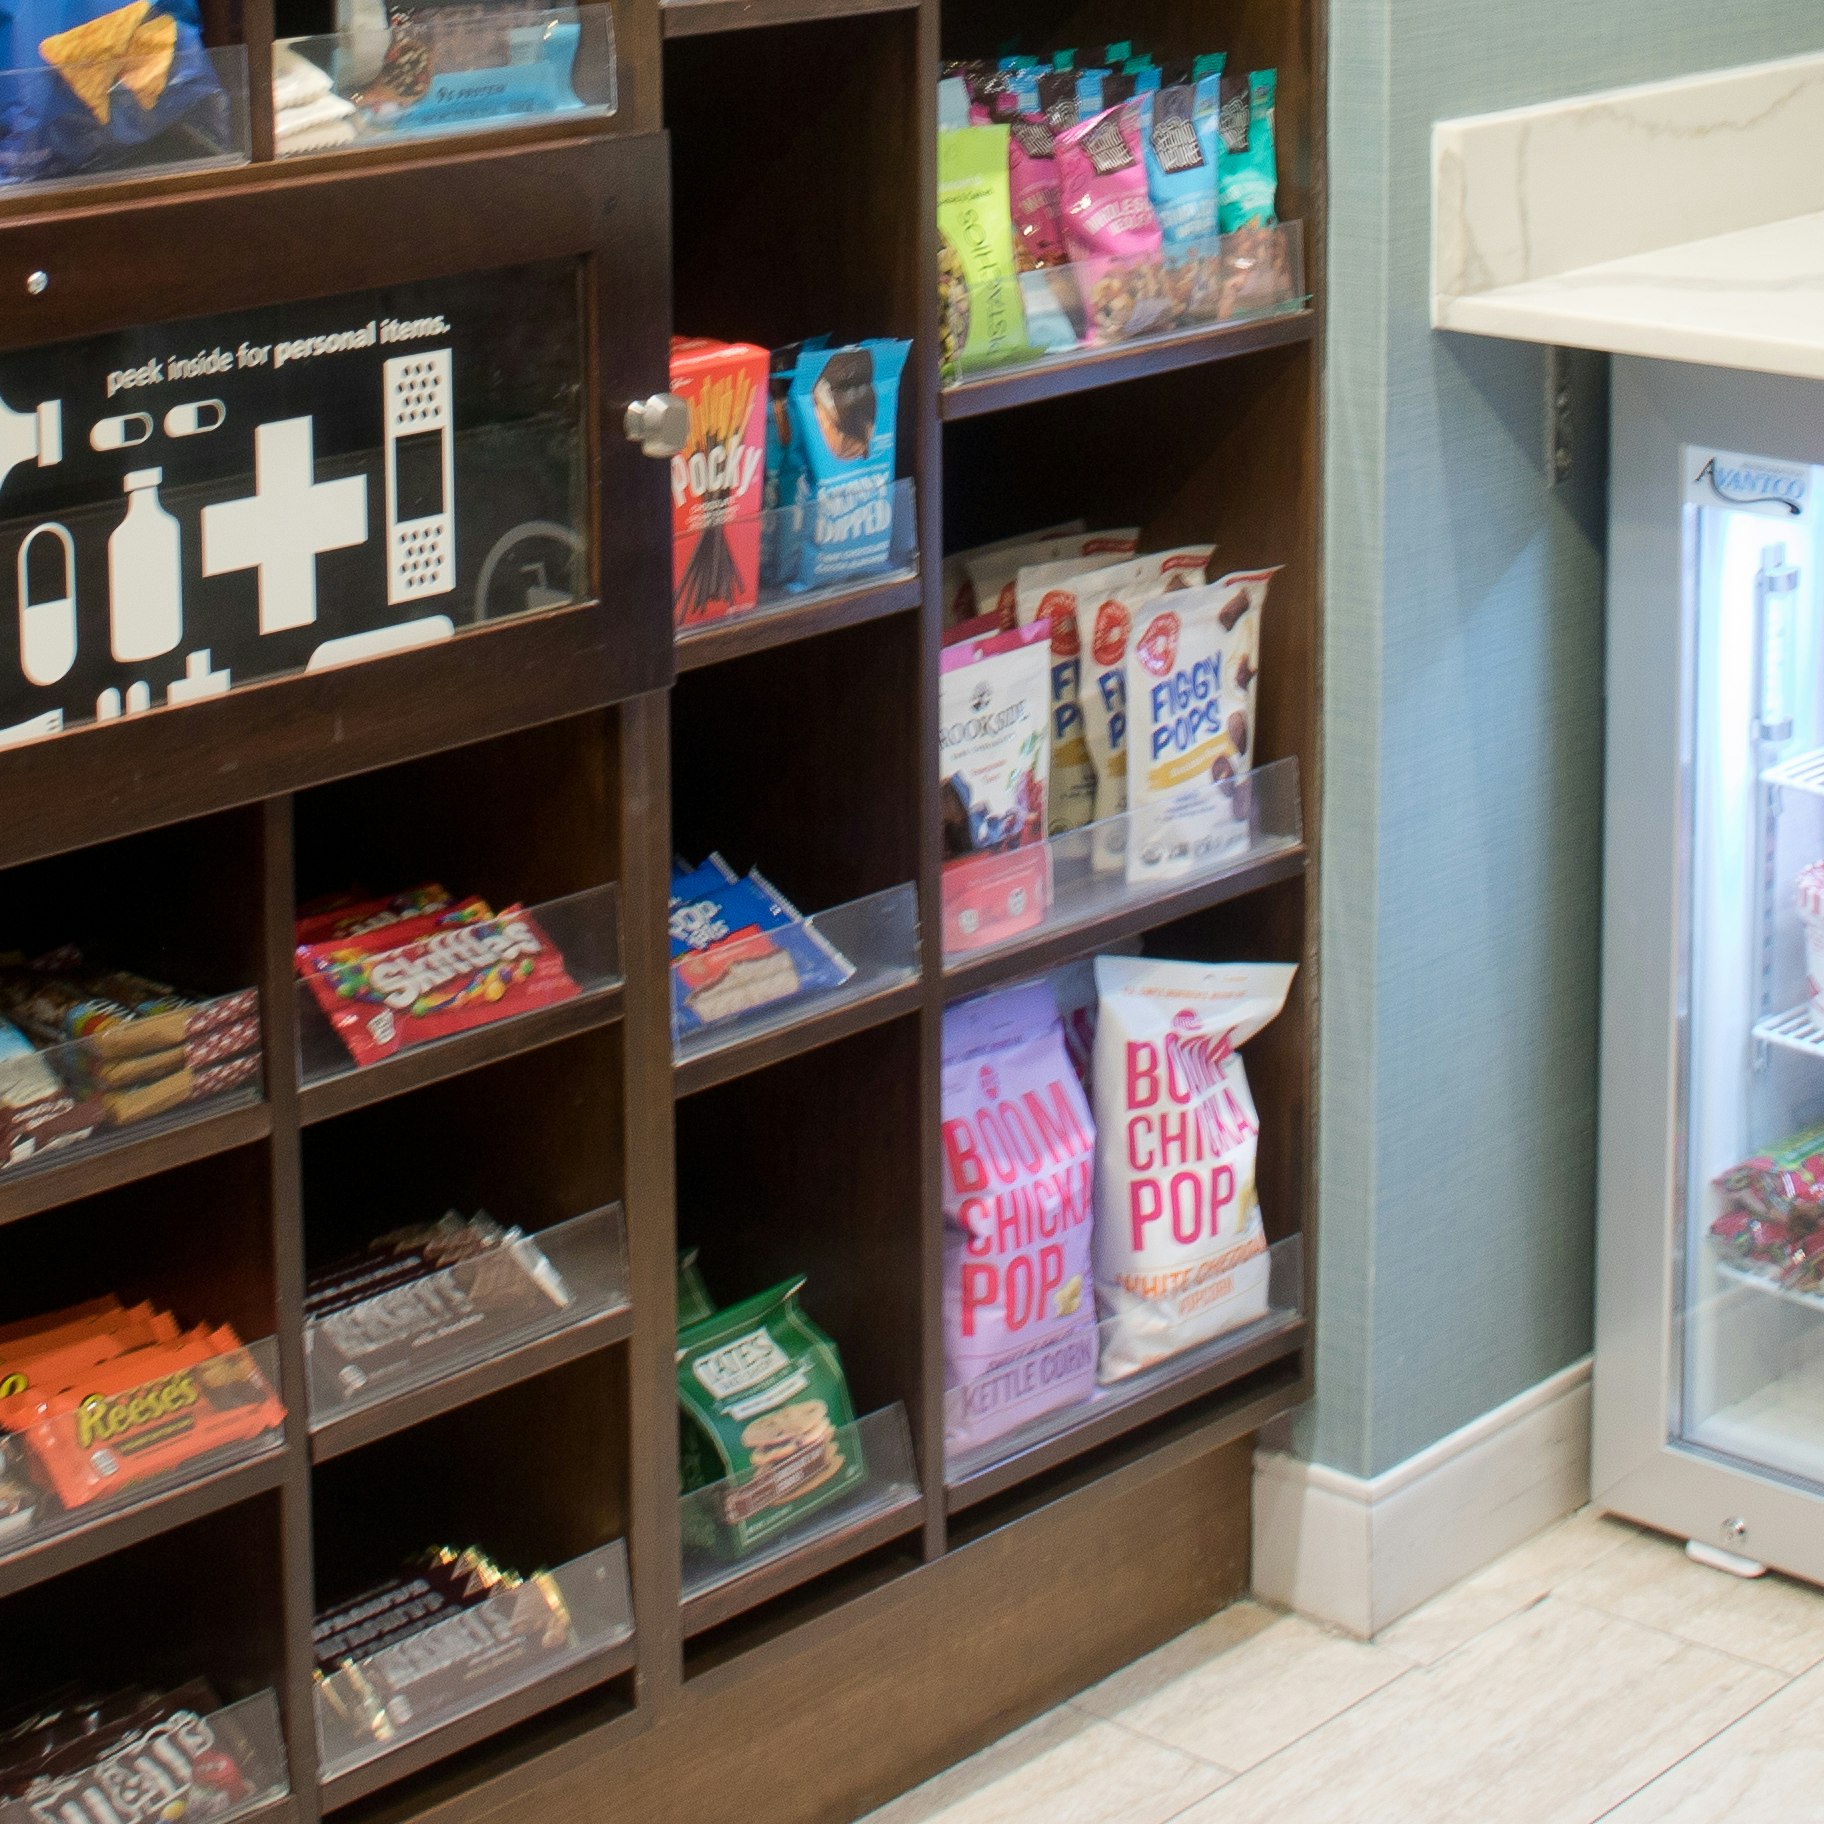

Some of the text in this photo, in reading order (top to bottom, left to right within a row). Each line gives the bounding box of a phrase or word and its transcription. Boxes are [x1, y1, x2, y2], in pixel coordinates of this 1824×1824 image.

[106, 311, 451, 398] peek inside for personal items.
[1150, 650, 1223, 725] FIGGY
[1151, 698, 1223, 761] POPS
[372, 918, 543, 1007] Skittles
[941, 1081, 1095, 1195] BOOM
[1128, 1163, 1236, 1253] POP
[961, 1241, 1066, 1338] POP
